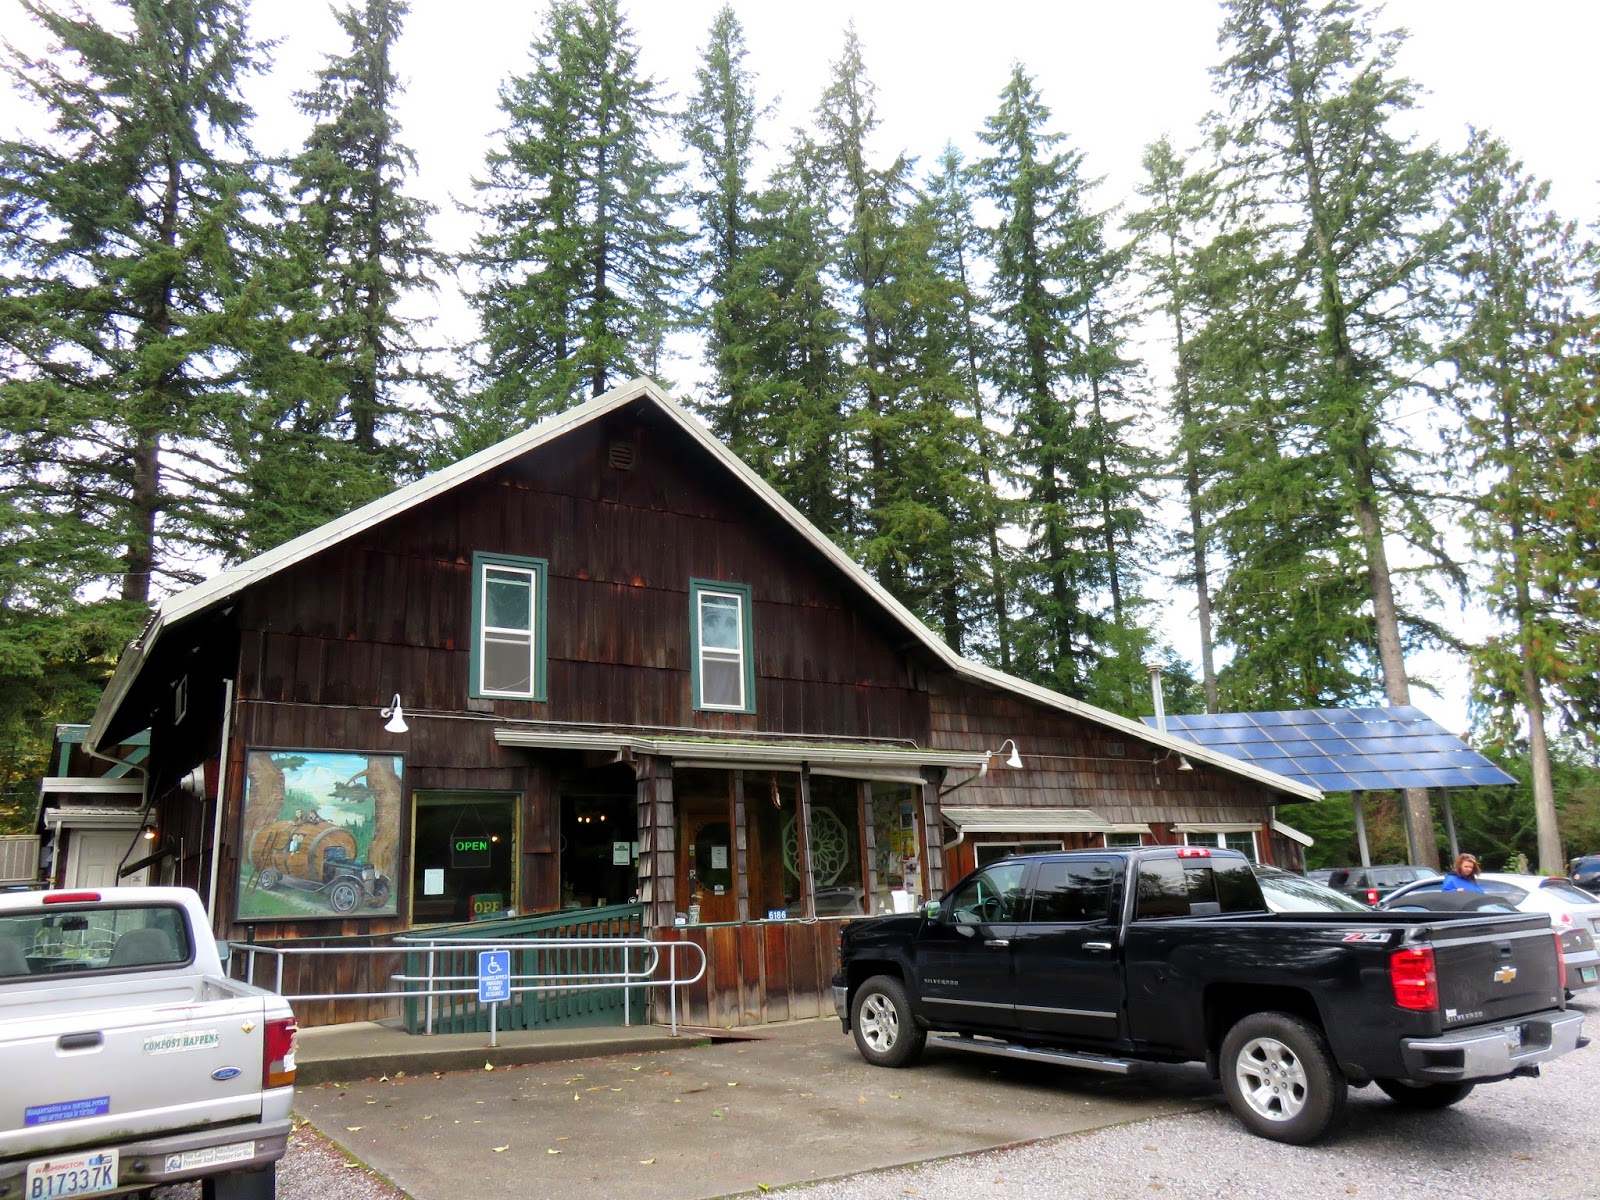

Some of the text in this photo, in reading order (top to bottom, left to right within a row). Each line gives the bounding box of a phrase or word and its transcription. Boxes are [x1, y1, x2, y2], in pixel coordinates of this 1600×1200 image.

[456, 841, 488, 851] OPEN
[768, 910, 786, 919] 6186
[923, 978, 959, 986] SILVERADO
[143, 1033, 219, 1051] COMPOST HAPPENS
[35, 1160, 85, 1174] WASHINGTON
[32, 1164, 113, 1199] B17337K
